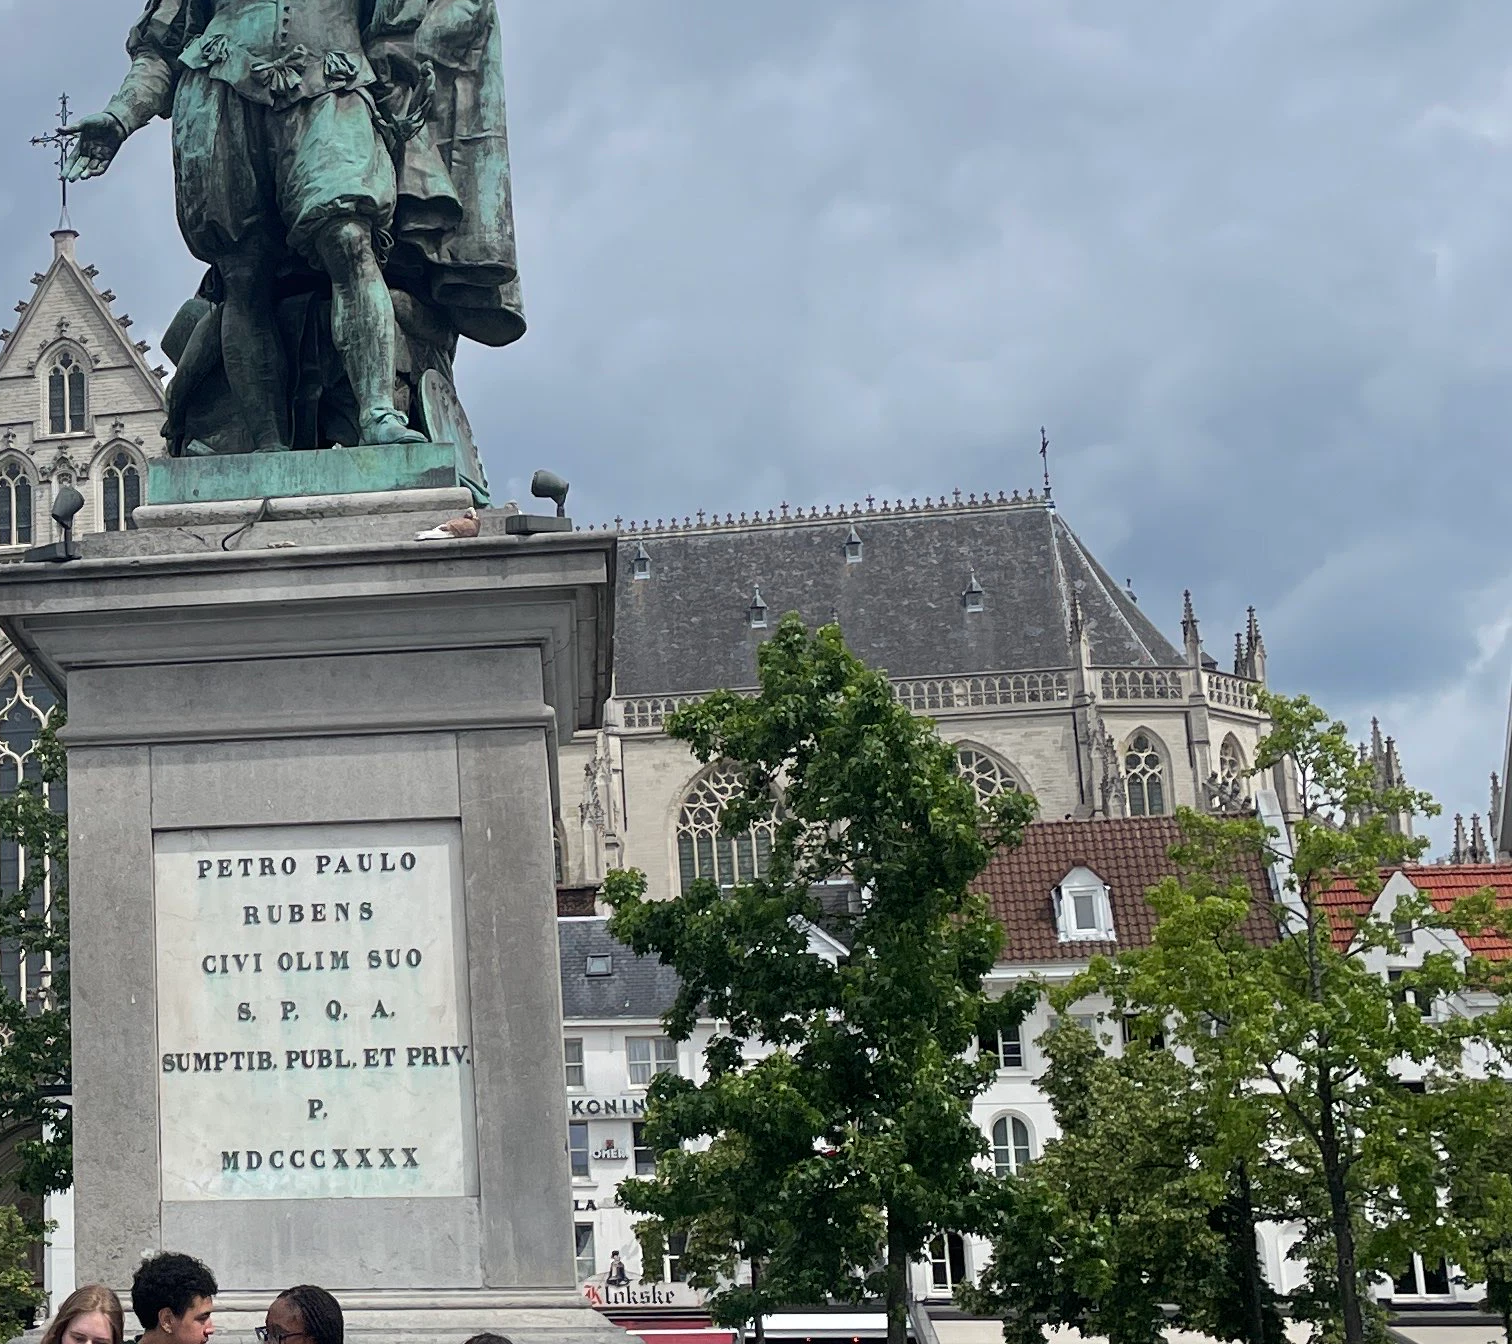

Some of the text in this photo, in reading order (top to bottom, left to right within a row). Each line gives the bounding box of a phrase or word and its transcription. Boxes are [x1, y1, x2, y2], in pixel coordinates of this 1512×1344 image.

[197, 852, 416, 879] PETRO PAULO
[243, 902, 374, 925] RUBENS
[202, 948, 422, 974] CIVI OLIM SUO
[238, 1000, 395, 1022] S. P. Q. A.
[162, 1045, 471, 1073] SUMPTIB. PUBL. ET PRIV.
[307, 1099, 328, 1120] P.
[221, 1147, 420, 1171] MDCCCXXXX
[583, 1283, 675, 1305] Klokske
